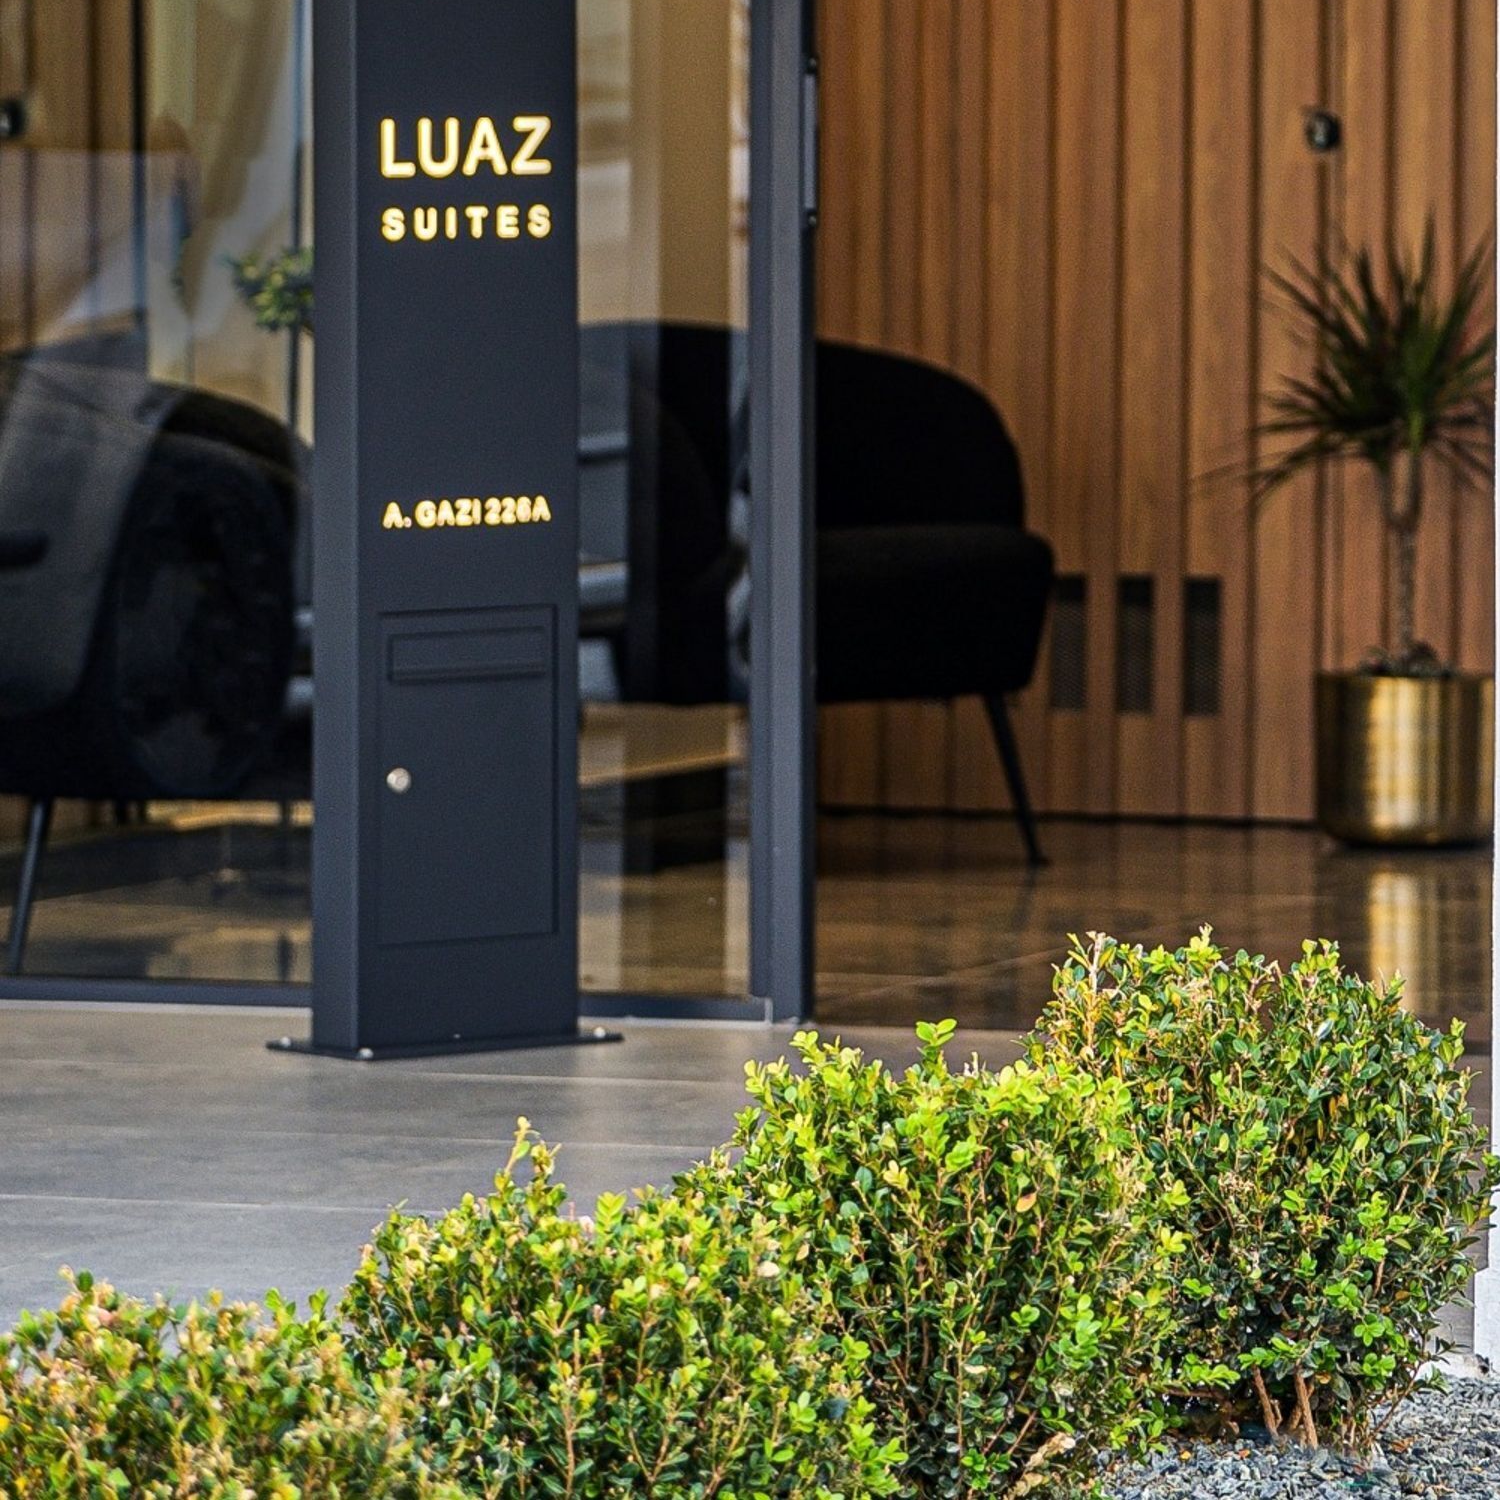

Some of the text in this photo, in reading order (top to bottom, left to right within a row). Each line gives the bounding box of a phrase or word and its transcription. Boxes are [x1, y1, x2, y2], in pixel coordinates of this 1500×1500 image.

[380, 116, 552, 178] LUAZ
[381, 204, 552, 242] SUITES
[382, 501, 412, 529] A.
[414, 498, 482, 528] GAZI
